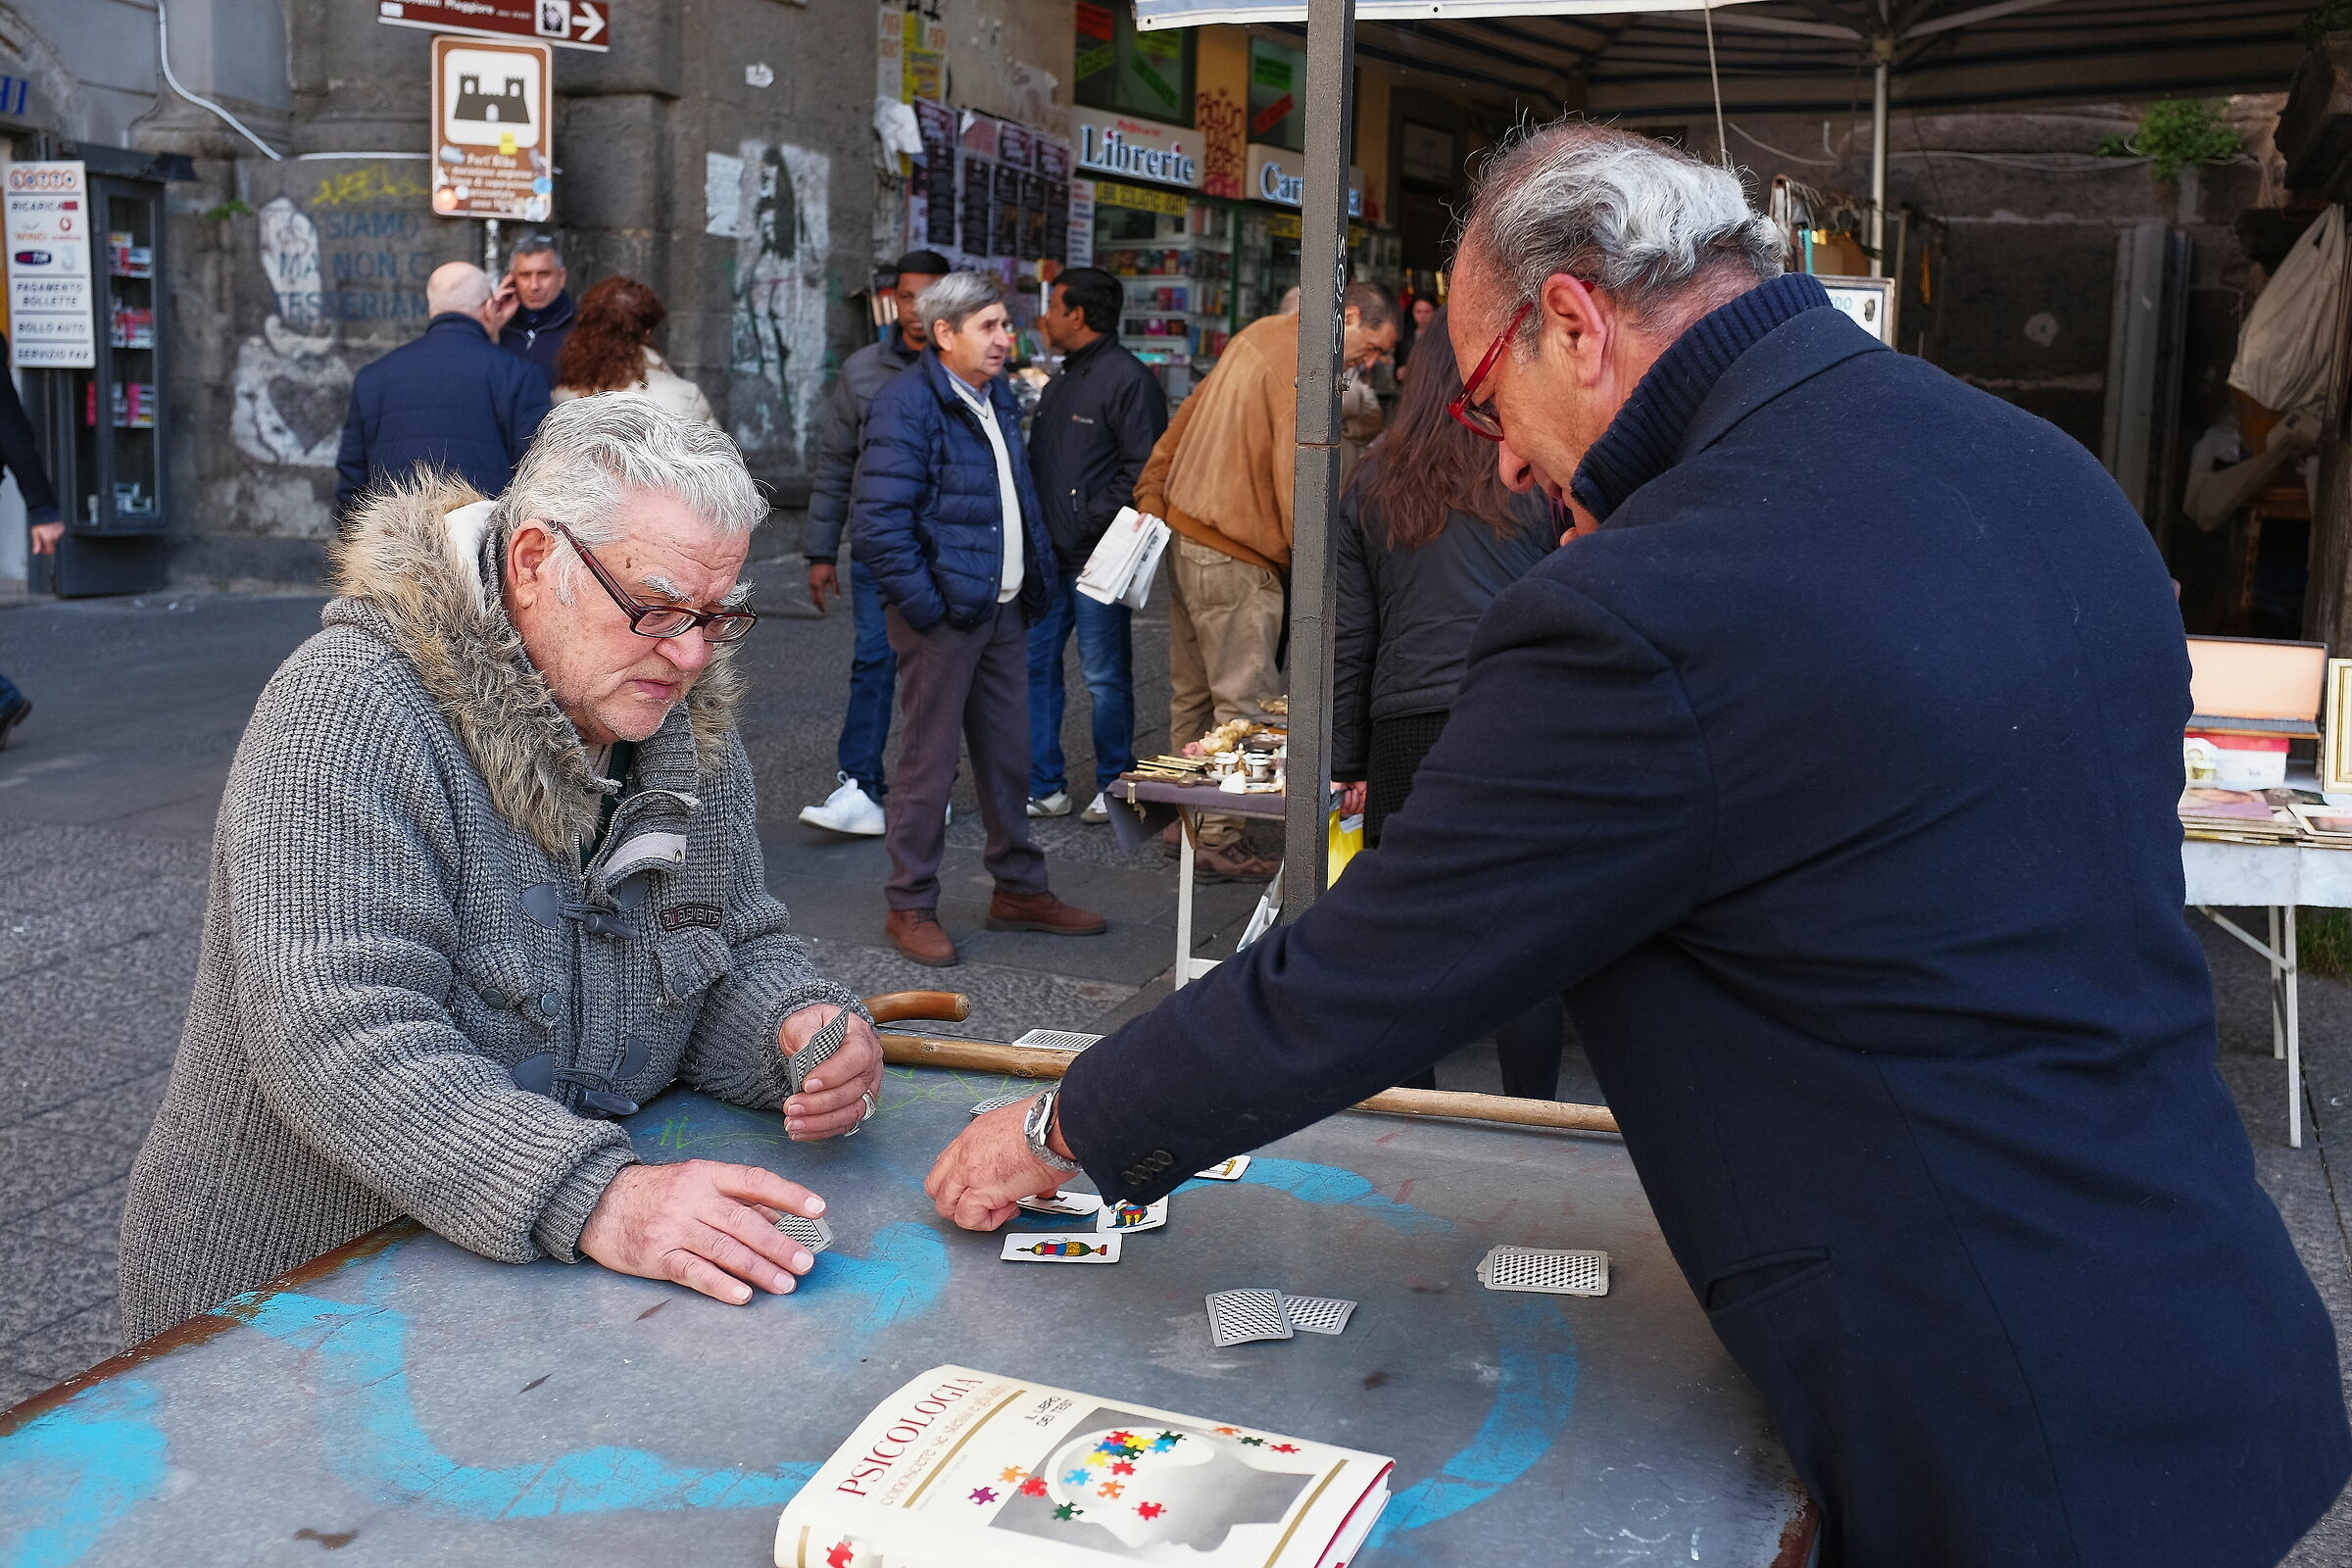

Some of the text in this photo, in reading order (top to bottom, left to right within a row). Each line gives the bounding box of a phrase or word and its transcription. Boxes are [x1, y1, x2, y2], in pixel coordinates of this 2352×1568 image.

[1080, 124, 1195, 185] Librerie
[836, 1378, 984, 1497] PSICOLOGIA
[880, 1448, 938, 1506] conoscere
[932, 1435, 950, 1448] se
